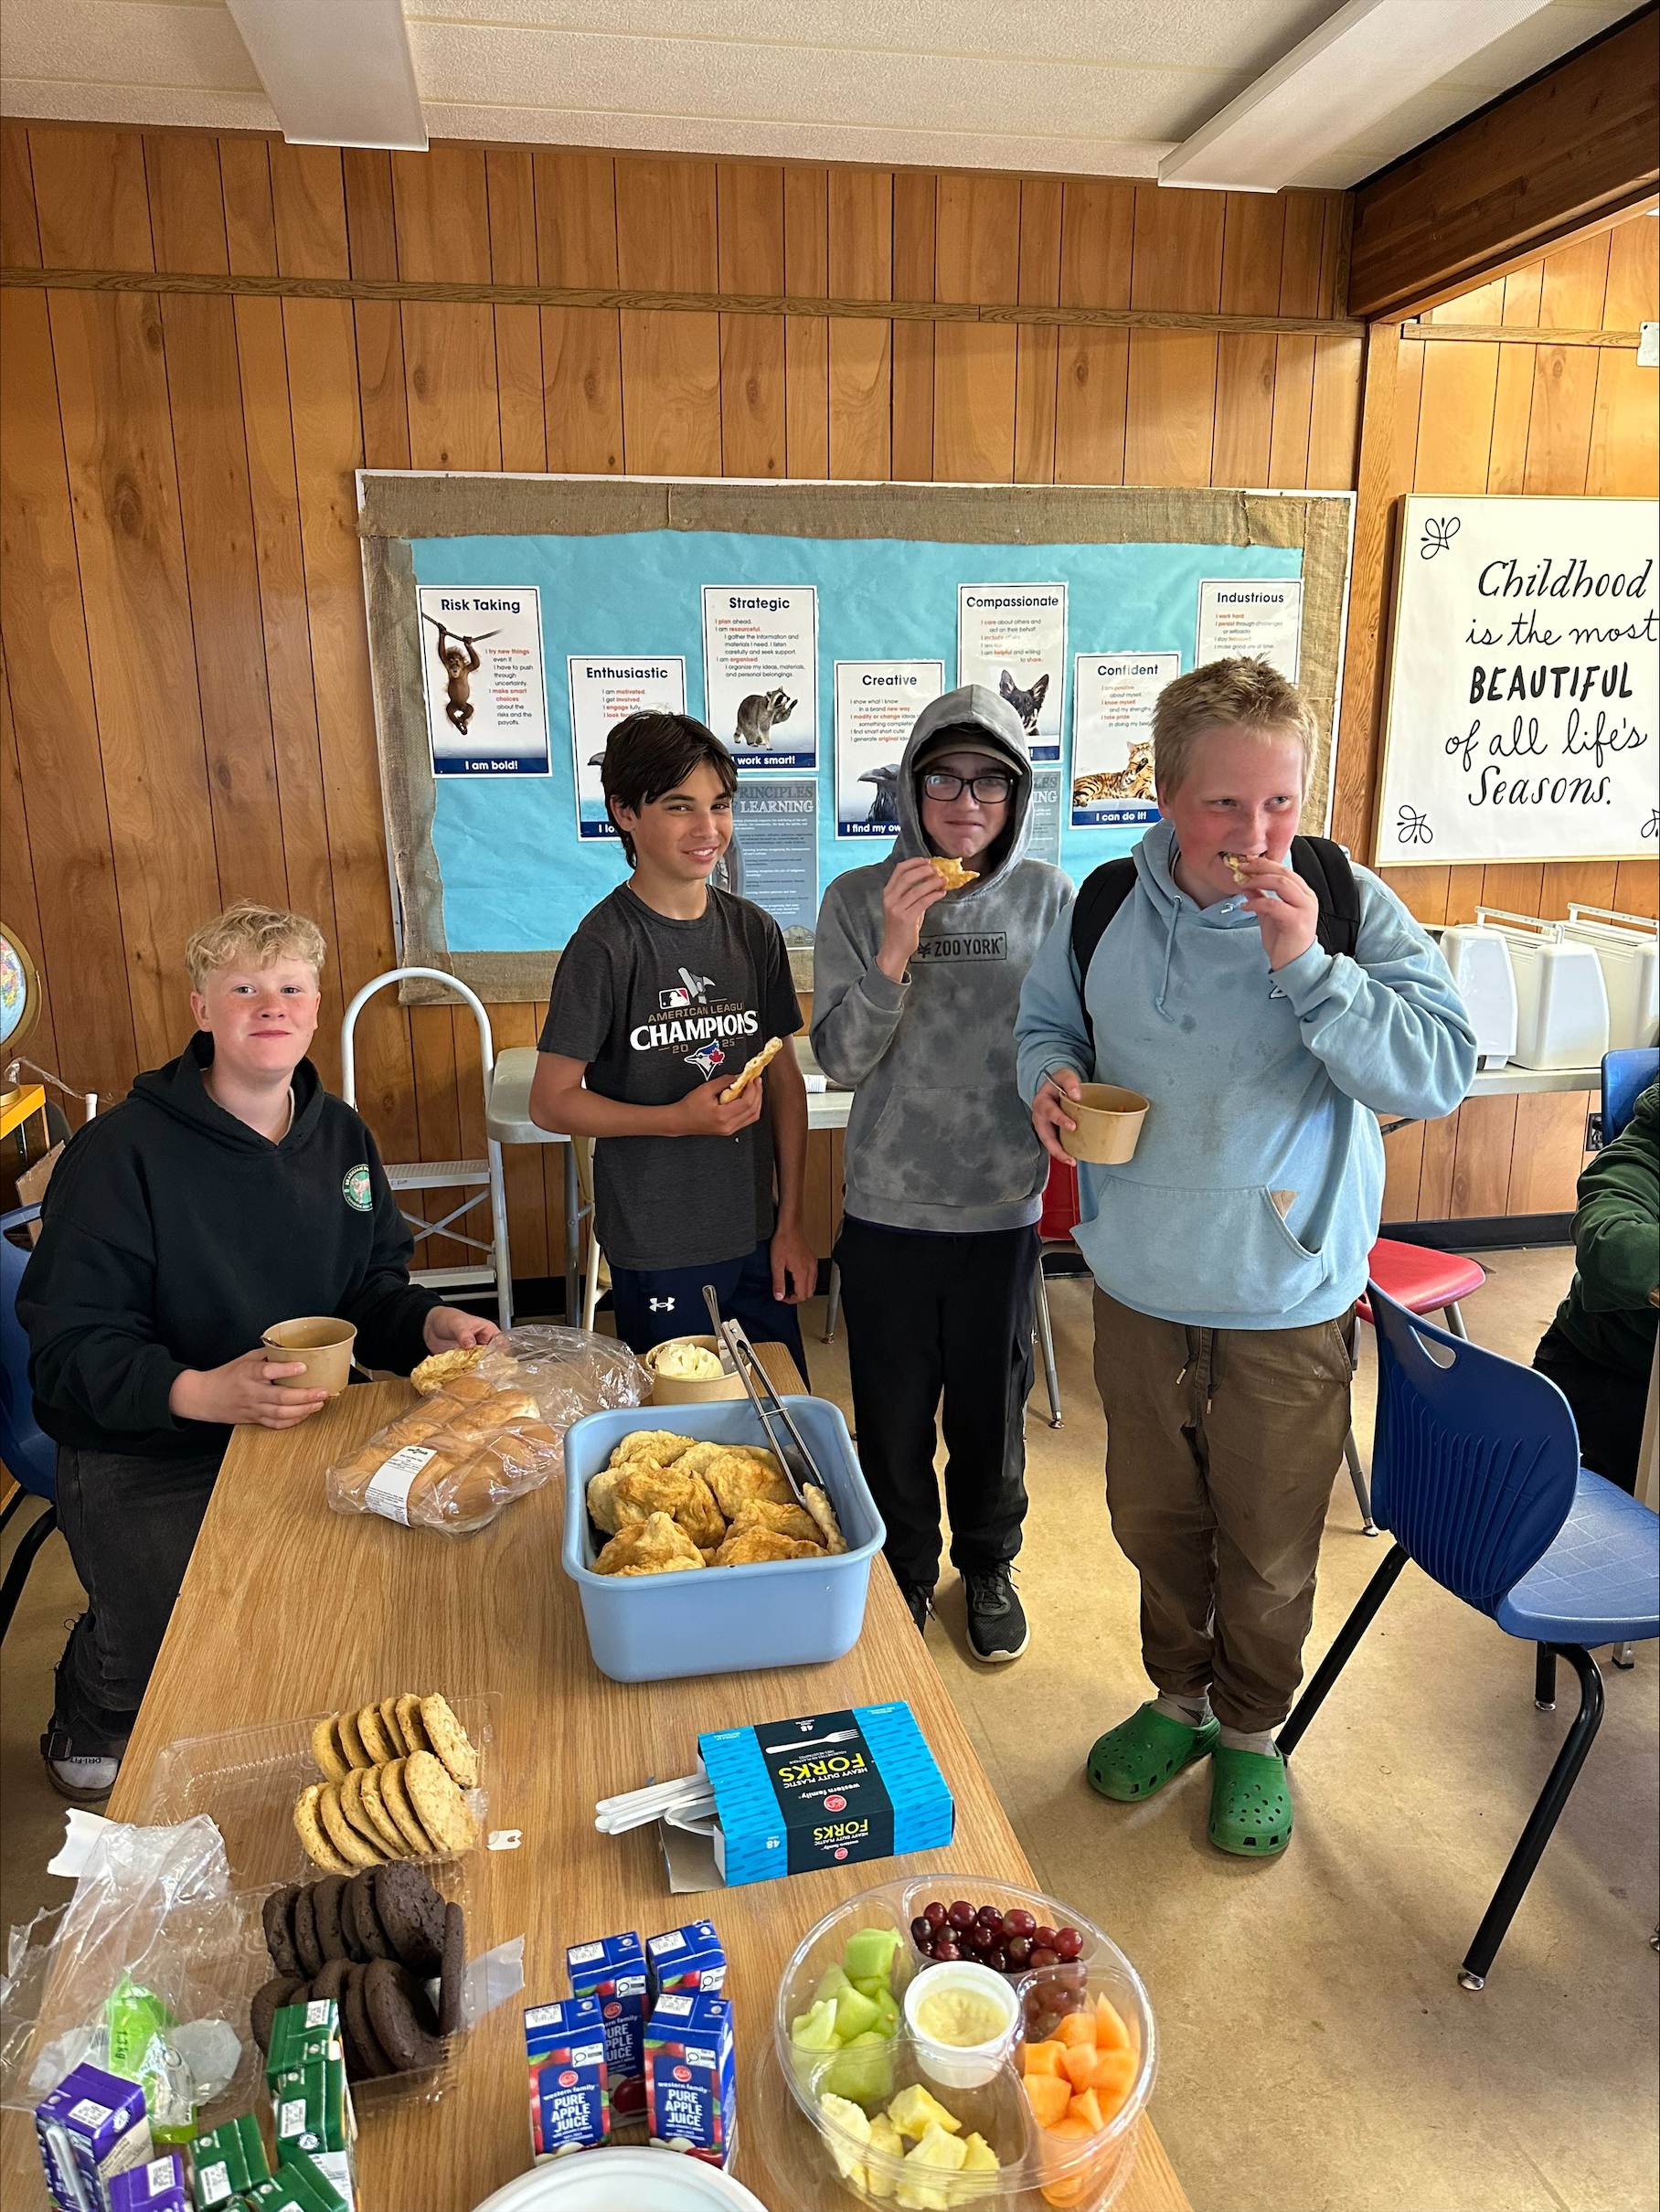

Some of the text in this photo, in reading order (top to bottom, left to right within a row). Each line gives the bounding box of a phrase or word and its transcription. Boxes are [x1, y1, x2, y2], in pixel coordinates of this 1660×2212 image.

[1479, 558, 1653, 598] Childhood
[729, 597, 790, 611] Strategic
[966, 596, 1059, 609] Compassionate
[1218, 592, 1283, 602] Industrious
[441, 600, 520, 614] Risk Taking
[1466, 609, 1660, 645] is the most
[587, 667, 668, 678] Enthusiastic
[1098, 665, 1158, 675] Confident
[862, 675, 917, 686] Creative
[1470, 662, 1633, 704] BEAUTIFUL
[1445, 707, 1647, 771] of all life's
[492, 760, 517, 770] bold!
[737, 756, 794, 765] work smart!
[1468, 765, 1611, 805] Seasons.
[740, 801, 814, 813] LEARNING
[852, 824, 869, 832] find
[872, 824, 886, 834] my
[935, 939, 1000, 956] ZOO YORK
[648, 1008, 708, 1023] AMERICAN
[630, 1010, 759, 1051] CHAMPIONS
[673, 1038, 735, 1054] 20 25
[778, 1752, 866, 1782] FORKS
[783, 1767, 867, 1788] HEAVY DUTY PLASTIC
[802, 1782, 860, 1799] western family
[814, 1819, 868, 1840] FORKS
[766, 1840, 780, 1849] 48
[617, 2015, 637, 2023] family
[607, 2023, 629, 2038] URE
[114, 2030, 128, 2059] 1.3 kg
[606, 2034, 633, 2050] PPLE
[607, 2046, 632, 2061] UICE
[543, 2084, 595, 2100] western family
[686, 2083, 708, 2093] family
[555, 2092, 586, 2110] PURE
[668, 2089, 698, 2103] PURE
[551, 2103, 591, 2122] APPLE
[665, 2101, 703, 2116] APPLE
[555, 2115, 590, 2132] JUICE
[667, 2112, 701, 2126] JUICE
